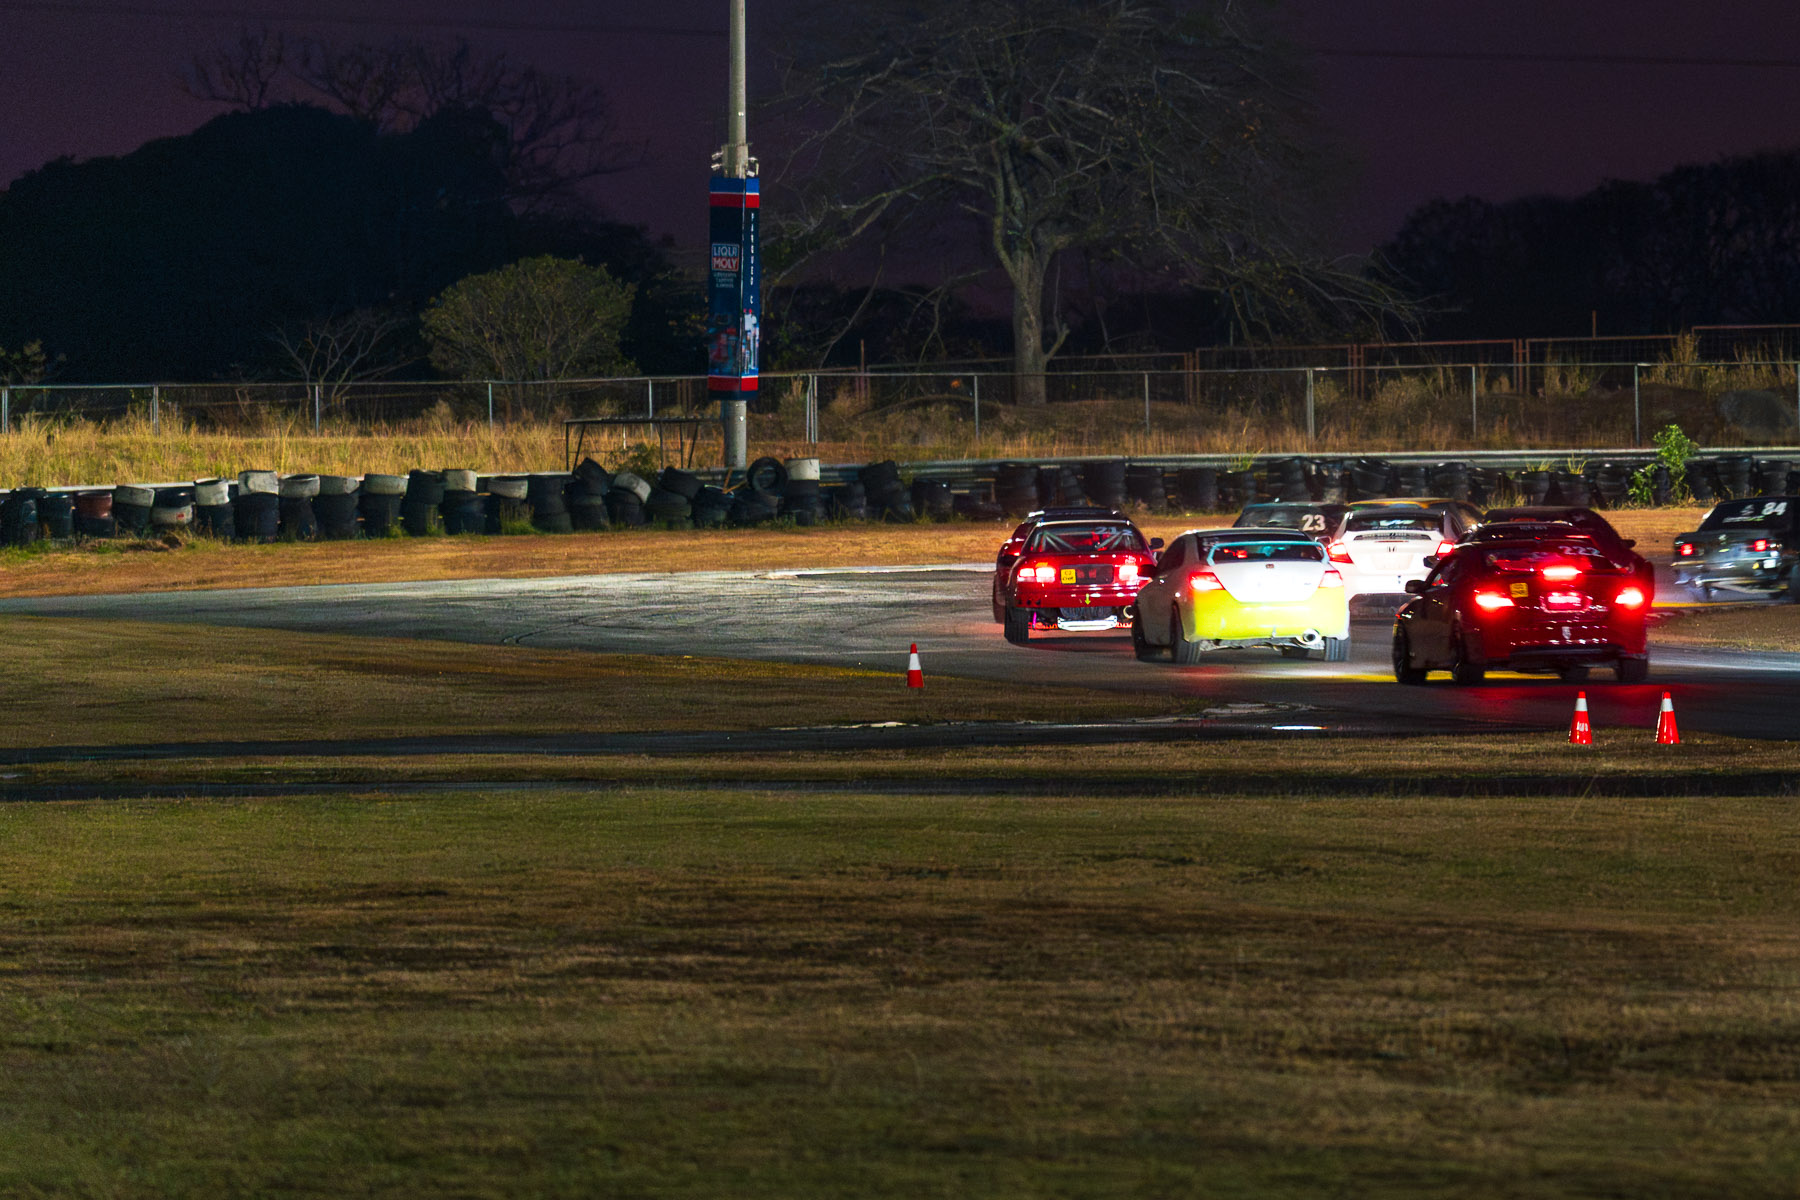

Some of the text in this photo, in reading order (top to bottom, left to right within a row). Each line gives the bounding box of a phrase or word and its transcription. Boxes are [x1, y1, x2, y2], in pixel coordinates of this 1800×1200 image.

[713, 246, 738, 257] LIQUI
[713, 258, 738, 269] MOLY
[1761, 501, 1788, 516] 84
[1301, 514, 1326, 532] 23
[1557, 545, 1605, 558] 222
